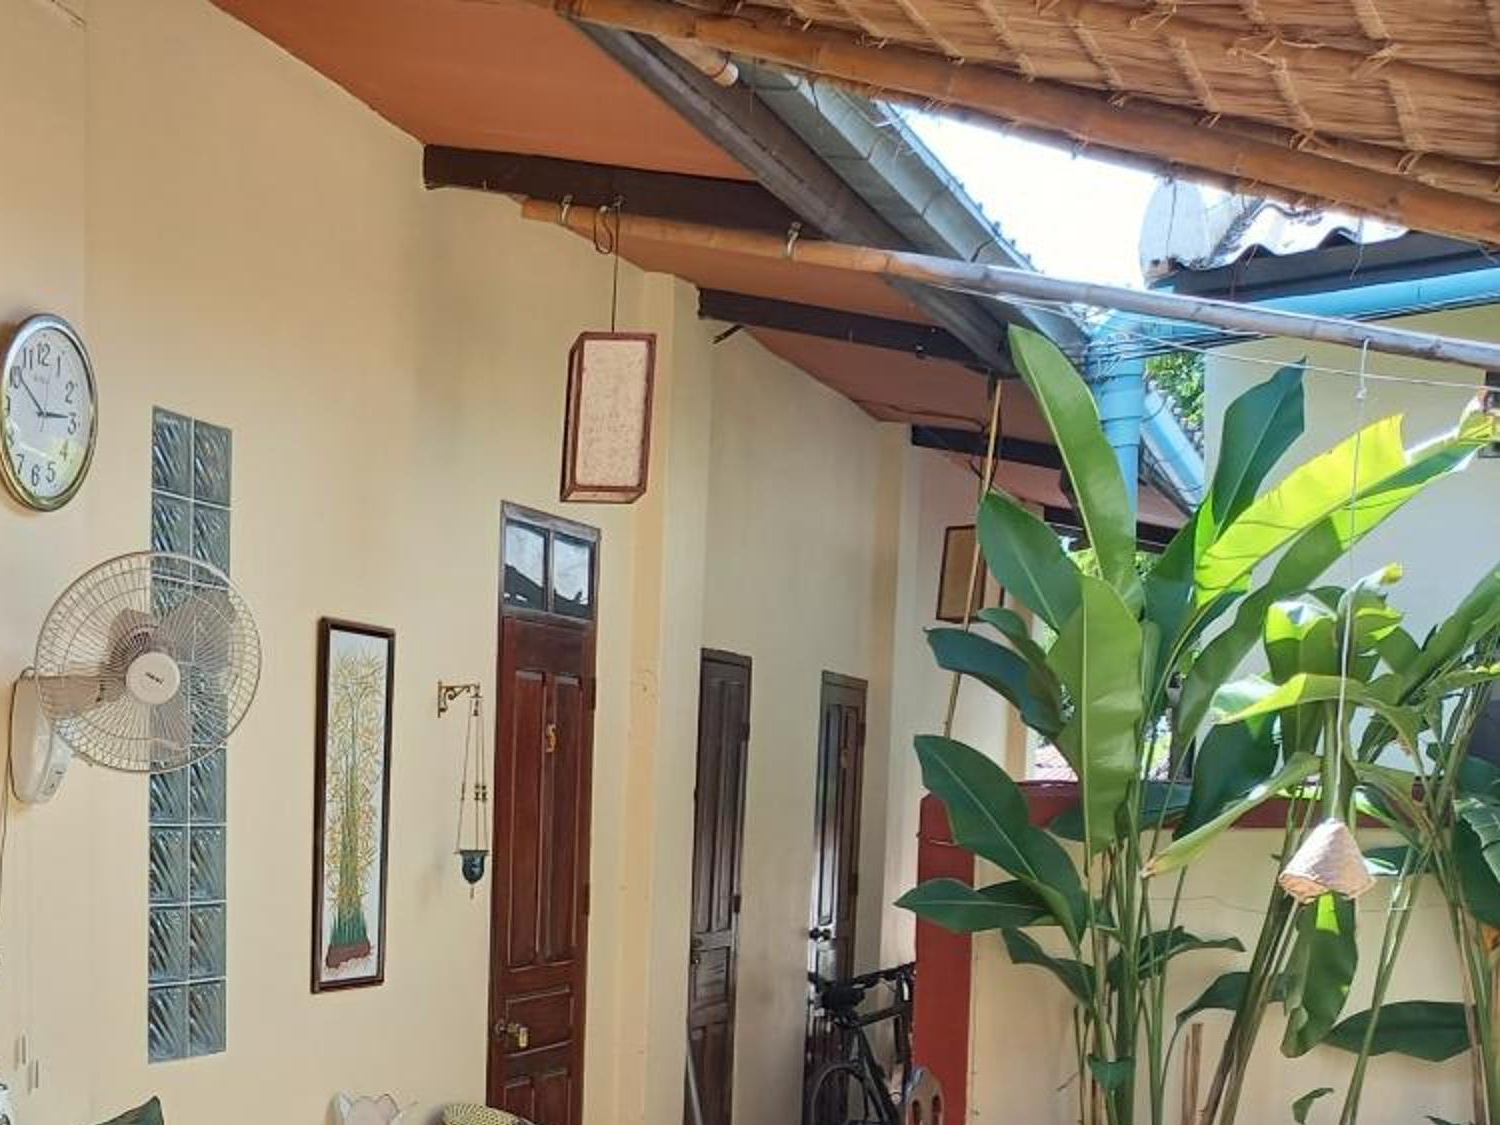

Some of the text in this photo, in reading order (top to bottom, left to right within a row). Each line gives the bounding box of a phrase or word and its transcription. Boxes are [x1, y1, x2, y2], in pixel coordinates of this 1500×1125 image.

[22, 347, 34, 371] 11
[37, 343, 51, 367] 12
[65, 381, 75, 404] 2
[67, 412, 77, 436] 3
[60, 443, 69, 462] 4
[16, 453, 25, 476] 7
[31, 463, 41, 487] 6
[45, 461, 56, 483] 5
